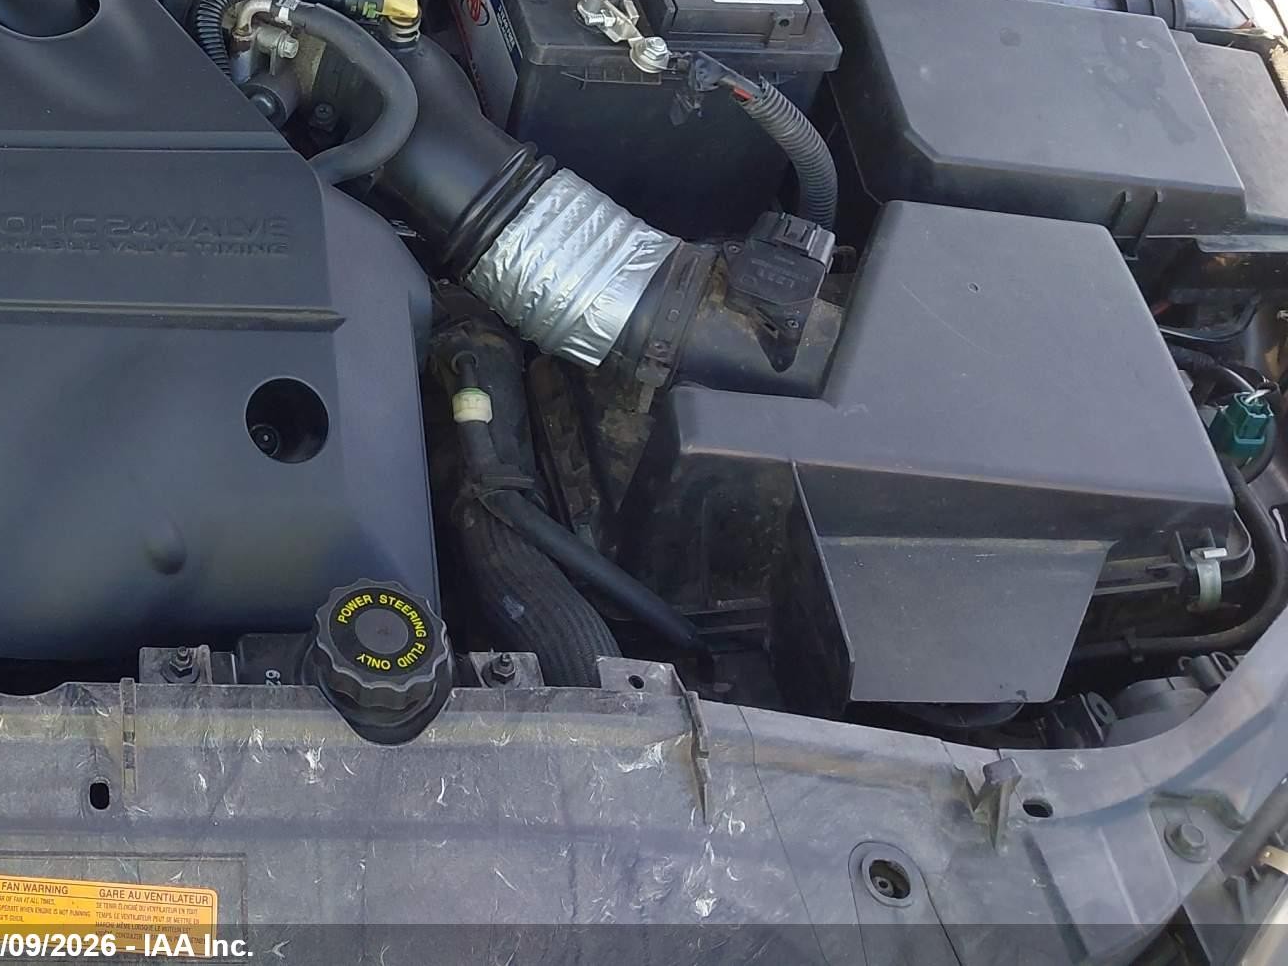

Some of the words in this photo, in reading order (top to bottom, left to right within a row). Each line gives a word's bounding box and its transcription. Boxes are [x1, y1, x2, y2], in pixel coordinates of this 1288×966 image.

[337, 594, 374, 624] POWER
[378, 594, 428, 638] STEERING
[356, 652, 392, 671] ONLY
[397, 642, 426, 668] FLUID
[1, 881, 21, 891] FAN
[22, 883, 69, 895] WARNING
[99, 889, 125, 899] GARE
[128, 891, 141, 900] AU
[144, 892, 209, 904] VENTILATEUR
[147, 906, 178, 914] VENTILATEUR
